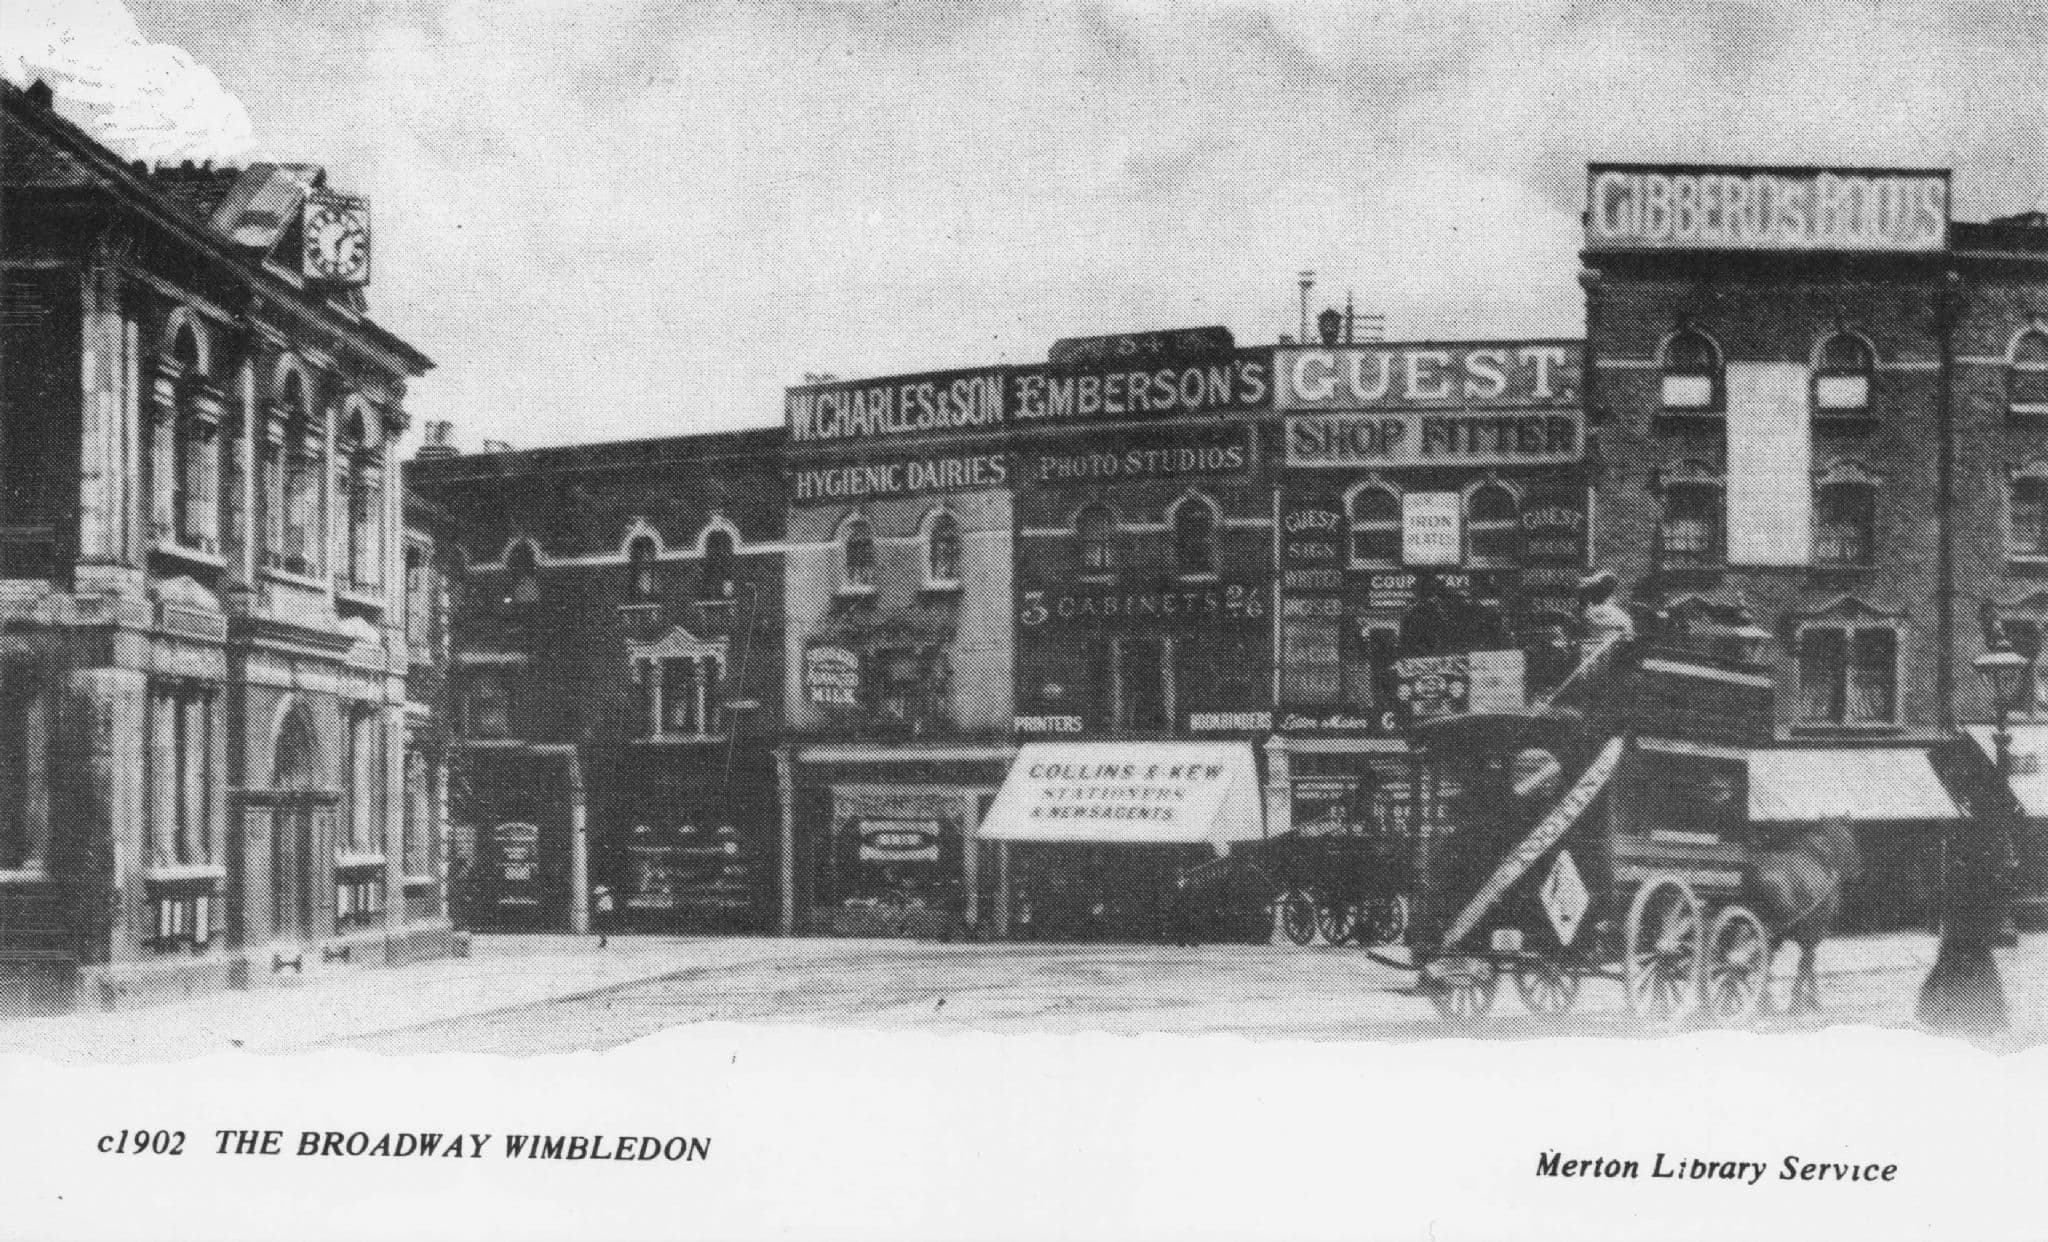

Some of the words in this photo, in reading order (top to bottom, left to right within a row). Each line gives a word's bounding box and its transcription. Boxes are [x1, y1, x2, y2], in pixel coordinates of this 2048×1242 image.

[1013, 360, 1267, 418] EMBERSON'S
[1293, 416, 1405, 458] SHOP
[1420, 414, 1574, 454] FITTER
[1039, 453, 1119, 481] PHOTO
[1123, 444, 1245, 473] STUDIOS
[796, 463, 901, 499] HYGIENIC
[908, 453, 1006, 490] DAIRIES
[1284, 508, 1342, 534] GUEST
[1521, 506, 1584, 532] GUEST
[1056, 591, 1219, 619] CABINETS
[1013, 715, 1083, 733] PRINTERS
[1028, 763, 1135, 780] COLLINS
[1168, 762, 1225, 781] KEW
[1041, 786, 1187, 801] STATIONERS
[1049, 805, 1175, 822] NEWSAGENTS
